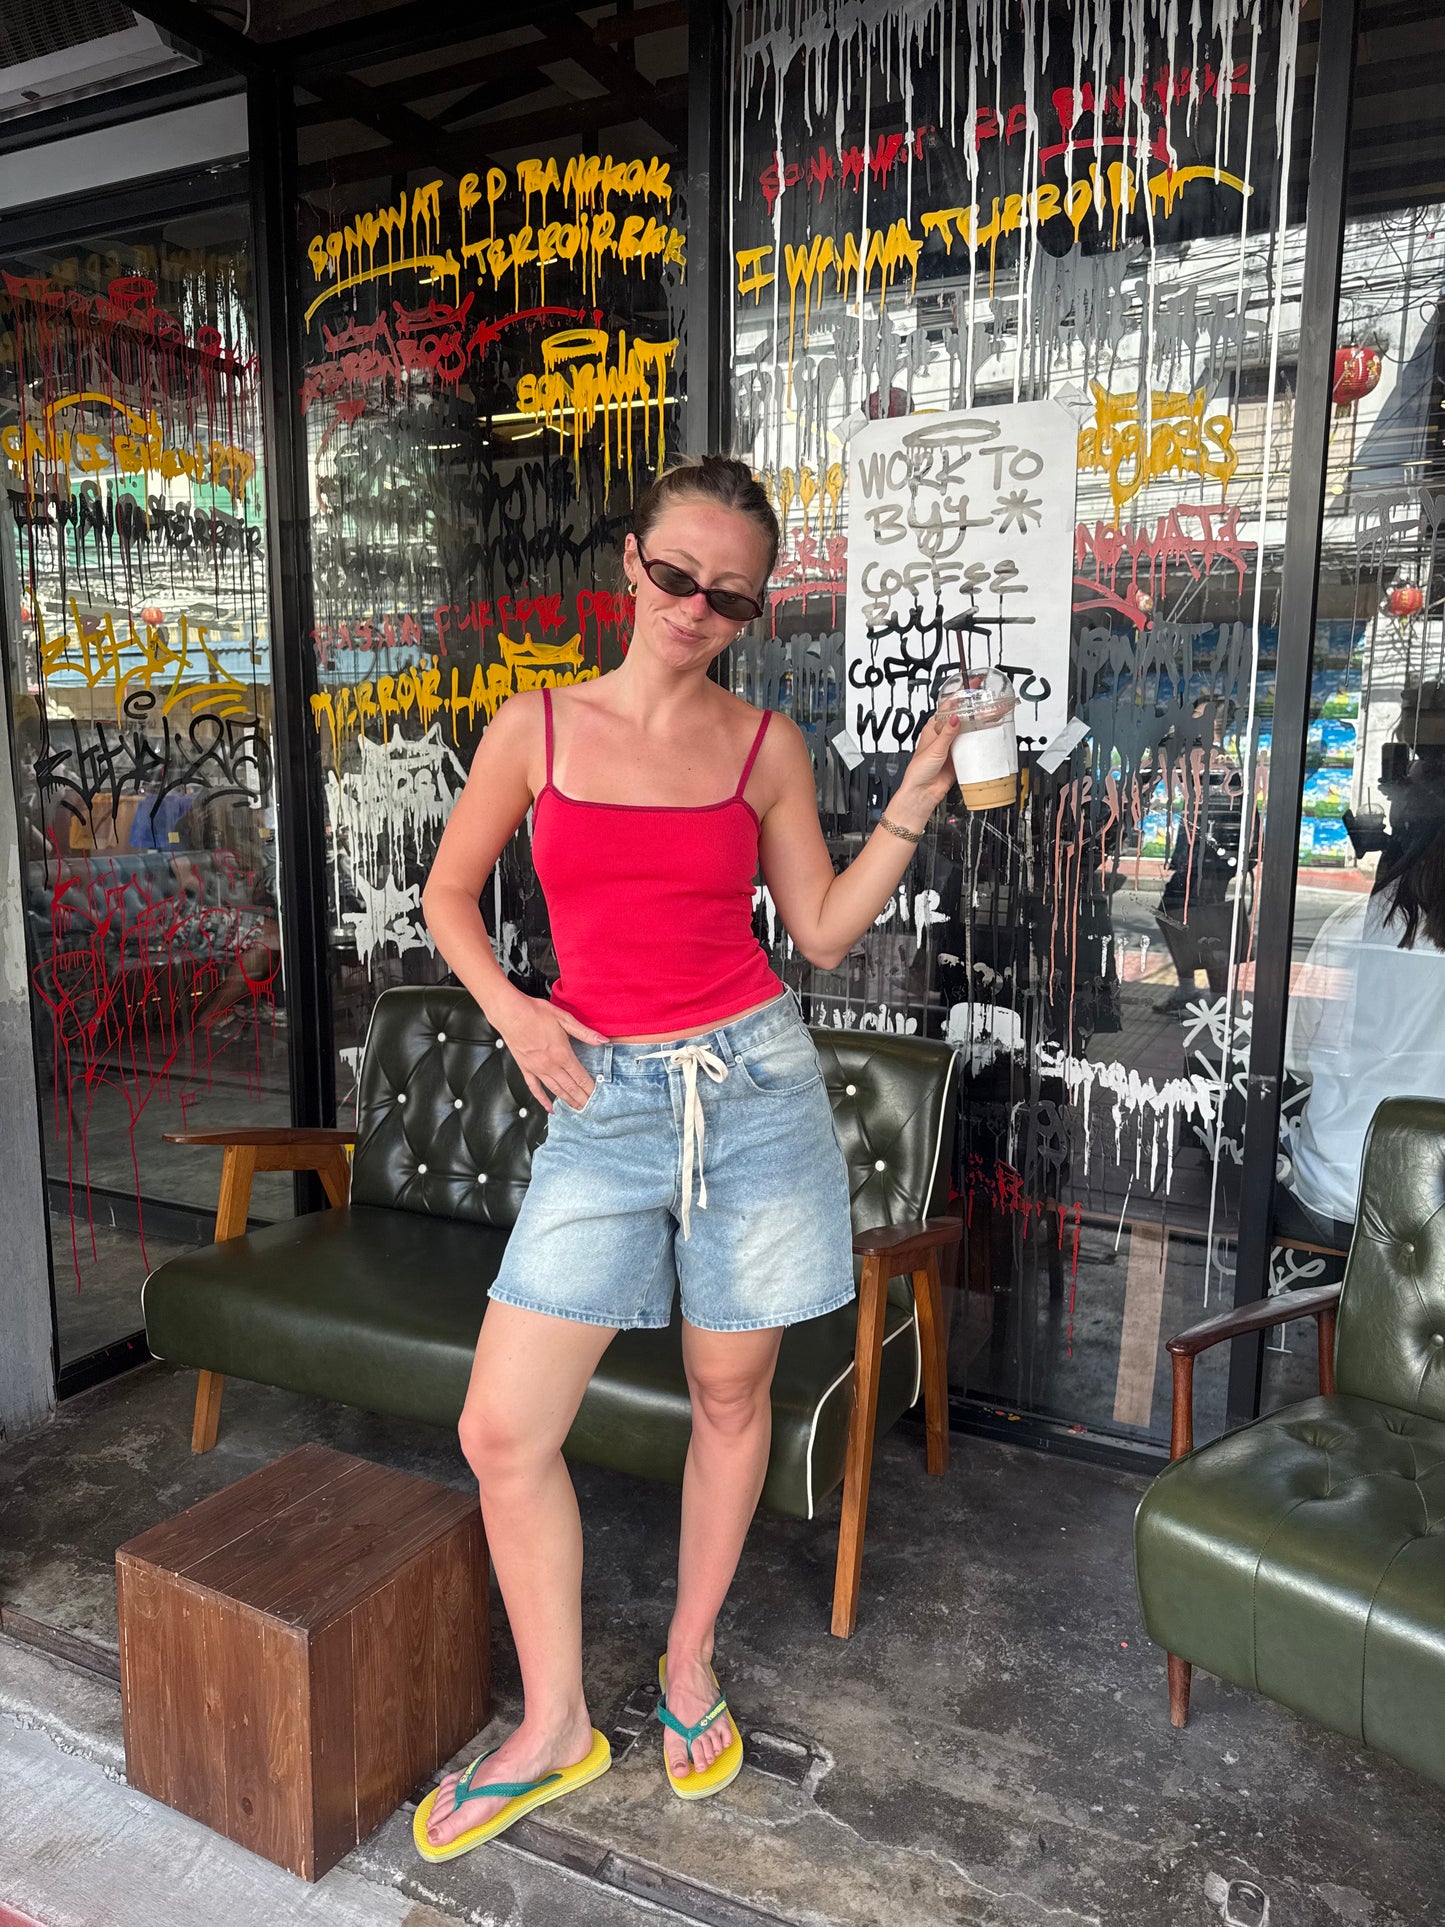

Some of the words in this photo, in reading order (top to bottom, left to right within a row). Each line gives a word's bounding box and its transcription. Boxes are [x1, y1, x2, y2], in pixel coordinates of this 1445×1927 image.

[308, 179, 444, 272] SONGWAT
[516, 154, 673, 205] BANGKOK
[736, 245, 774, 296] I
[784, 217, 923, 286] WANNA
[858, 450, 972, 500] WORK
[979, 445, 1044, 491] TO
[864, 494, 994, 559] BUY
[861, 560, 1029, 599] COFFEE
[861, 603, 944, 664] BUY
